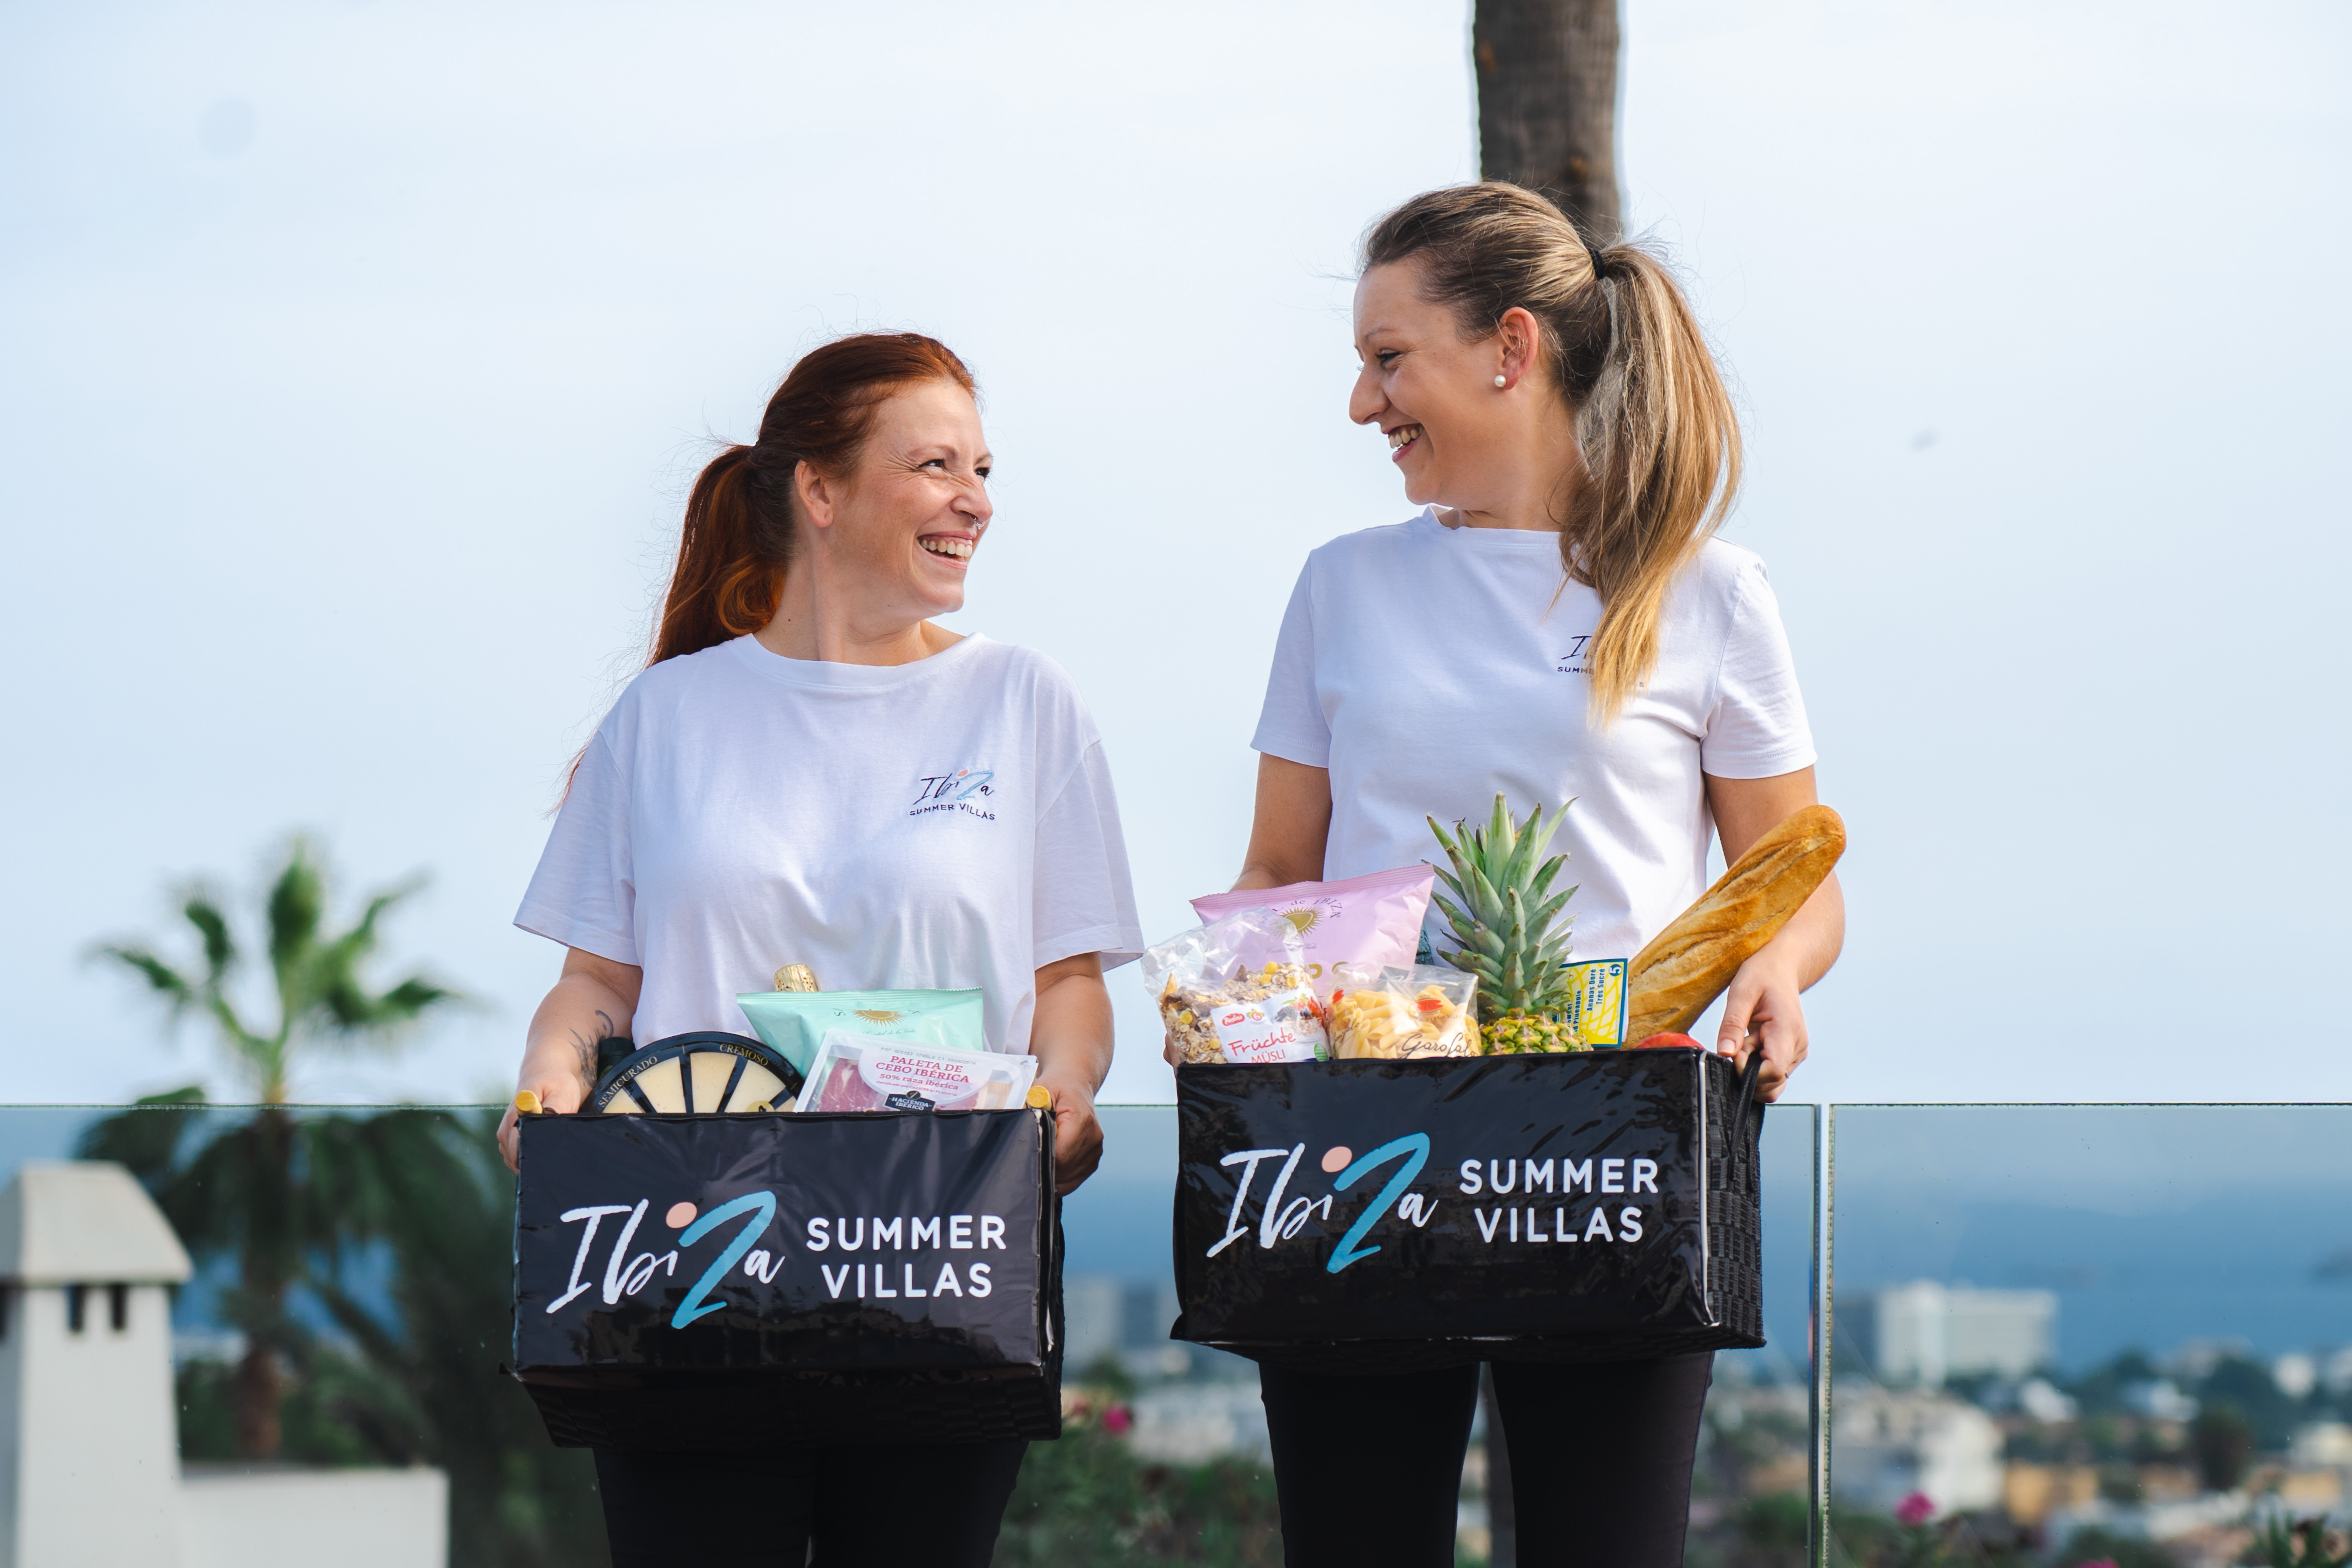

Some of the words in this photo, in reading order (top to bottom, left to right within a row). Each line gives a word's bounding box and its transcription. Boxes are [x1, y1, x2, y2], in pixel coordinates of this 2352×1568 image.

[1557, 666, 1594, 674] SUMME
[909, 804, 954, 815] SUMMER
[959, 803, 995, 820] VILLAS
[1313, 898, 1342, 919] IBIZA
[1589, 968, 1597, 985] Doré
[1597, 968, 1605, 988] Sucré
[1609, 965, 1622, 974] 5
[1587, 986, 1595, 1012] Ananas
[1596, 990, 1604, 1006] Très
[1228, 1027, 1296, 1057] Früchte
[1399, 1033, 1479, 1058] Garofalo
[719, 1043, 769, 1066] CREMOSO
[890, 1055, 941, 1070] PALETA
[944, 1064, 963, 1073] DE
[1251, 1049, 1286, 1063] MÜSLI
[598, 1055, 658, 1108] SEMICURADO
[876, 1062, 912, 1073] CEBO
[913, 1068, 970, 1083] IBÉRICA
[925, 1079, 958, 1090] ibérica
[891, 1097, 929, 1107] HACIENDA
[1459, 1158, 1659, 1195] SUMMER
[806, 1215, 1007, 1251] SUMMER
[1474, 1206, 1644, 1243] VILLAS
[821, 1263, 993, 1299] VILLAS
